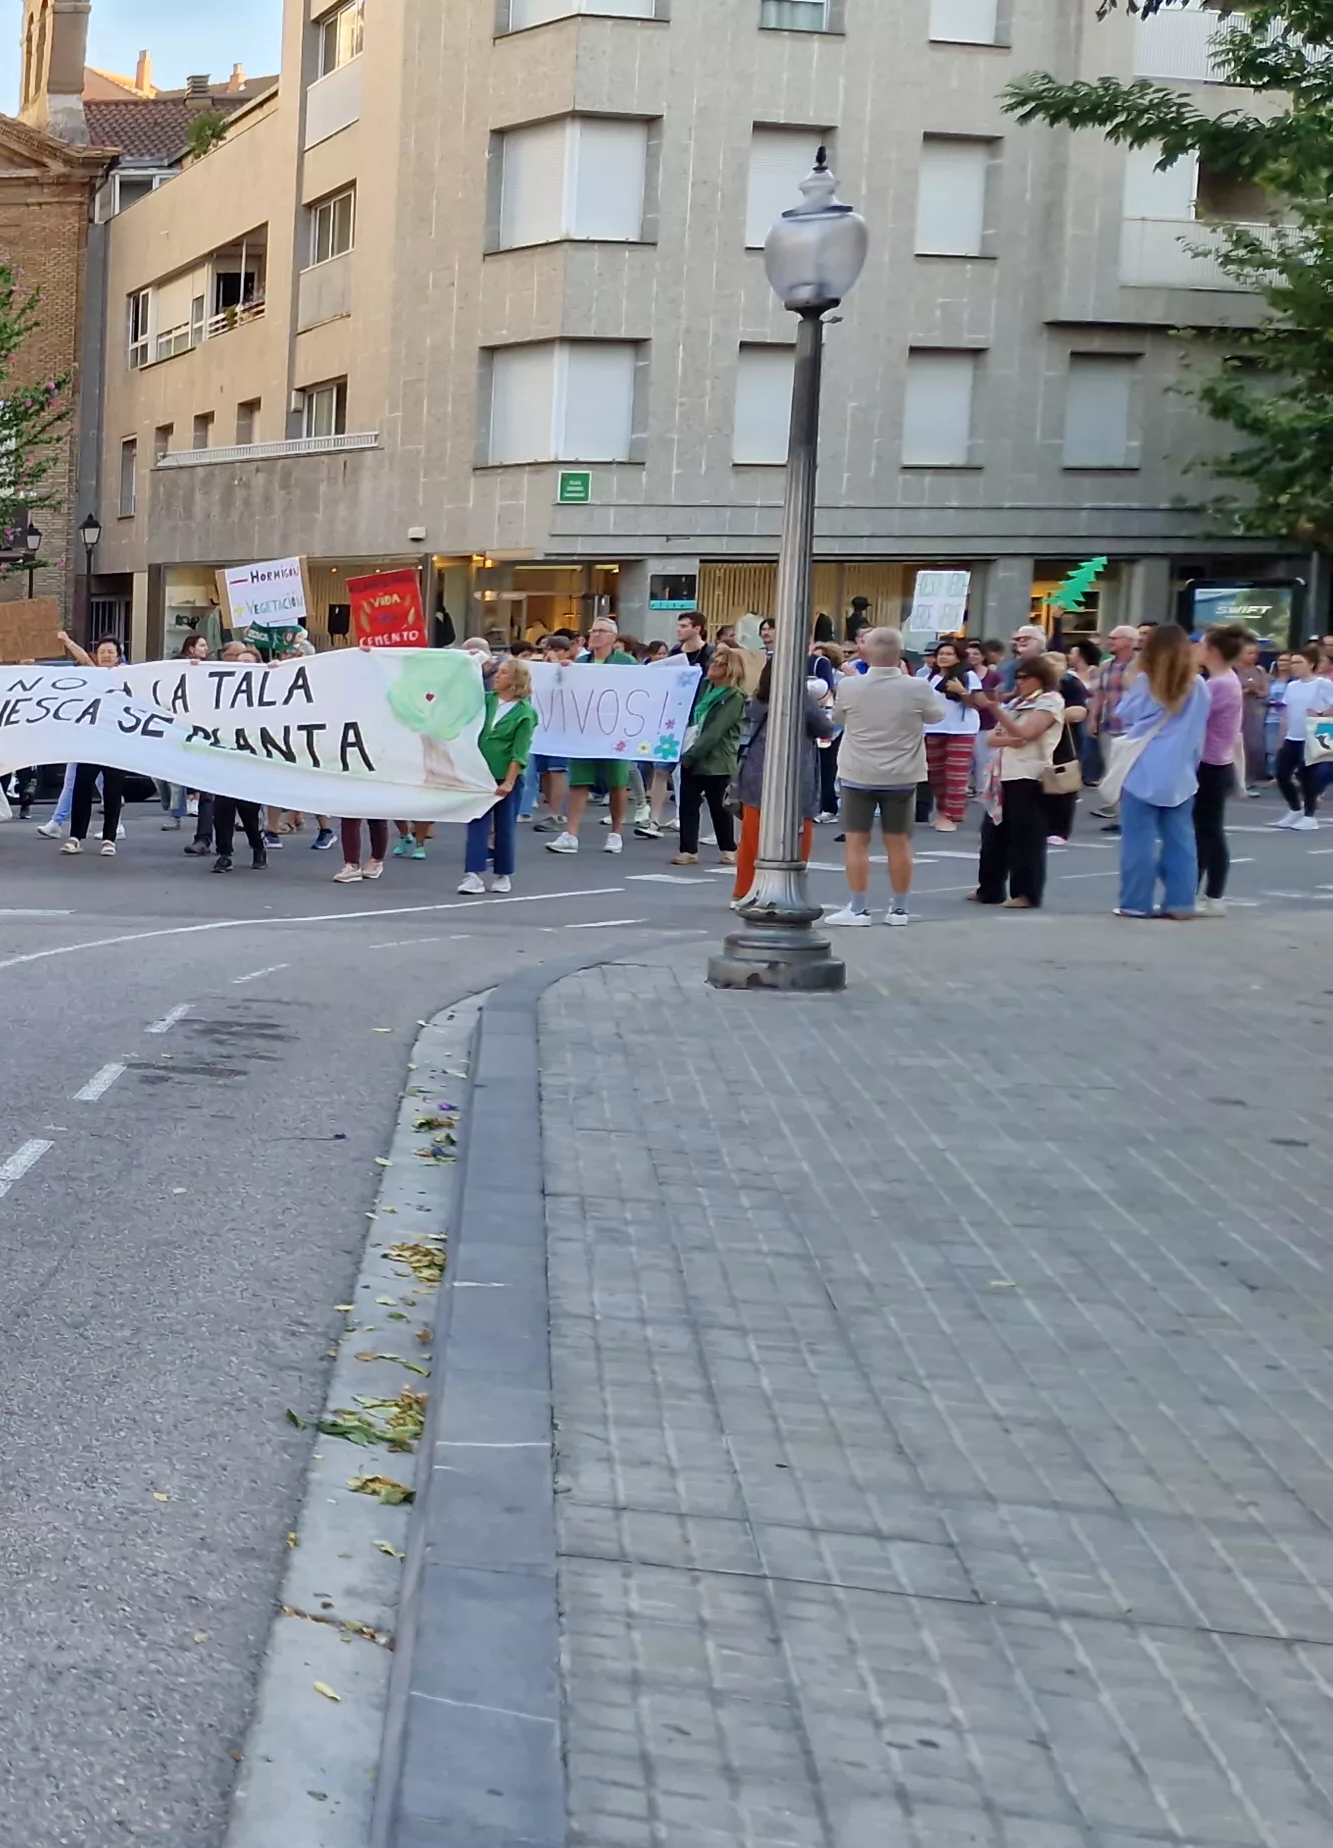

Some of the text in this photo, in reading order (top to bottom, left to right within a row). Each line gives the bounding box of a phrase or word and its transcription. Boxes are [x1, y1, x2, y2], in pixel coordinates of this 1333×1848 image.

[1215, 605, 1273, 614] SWIFT
[359, 630, 419, 648] CEMENTO
[7, 676, 88, 692] NO
[208, 666, 314, 710] TALA
[117, 705, 175, 738] SE
